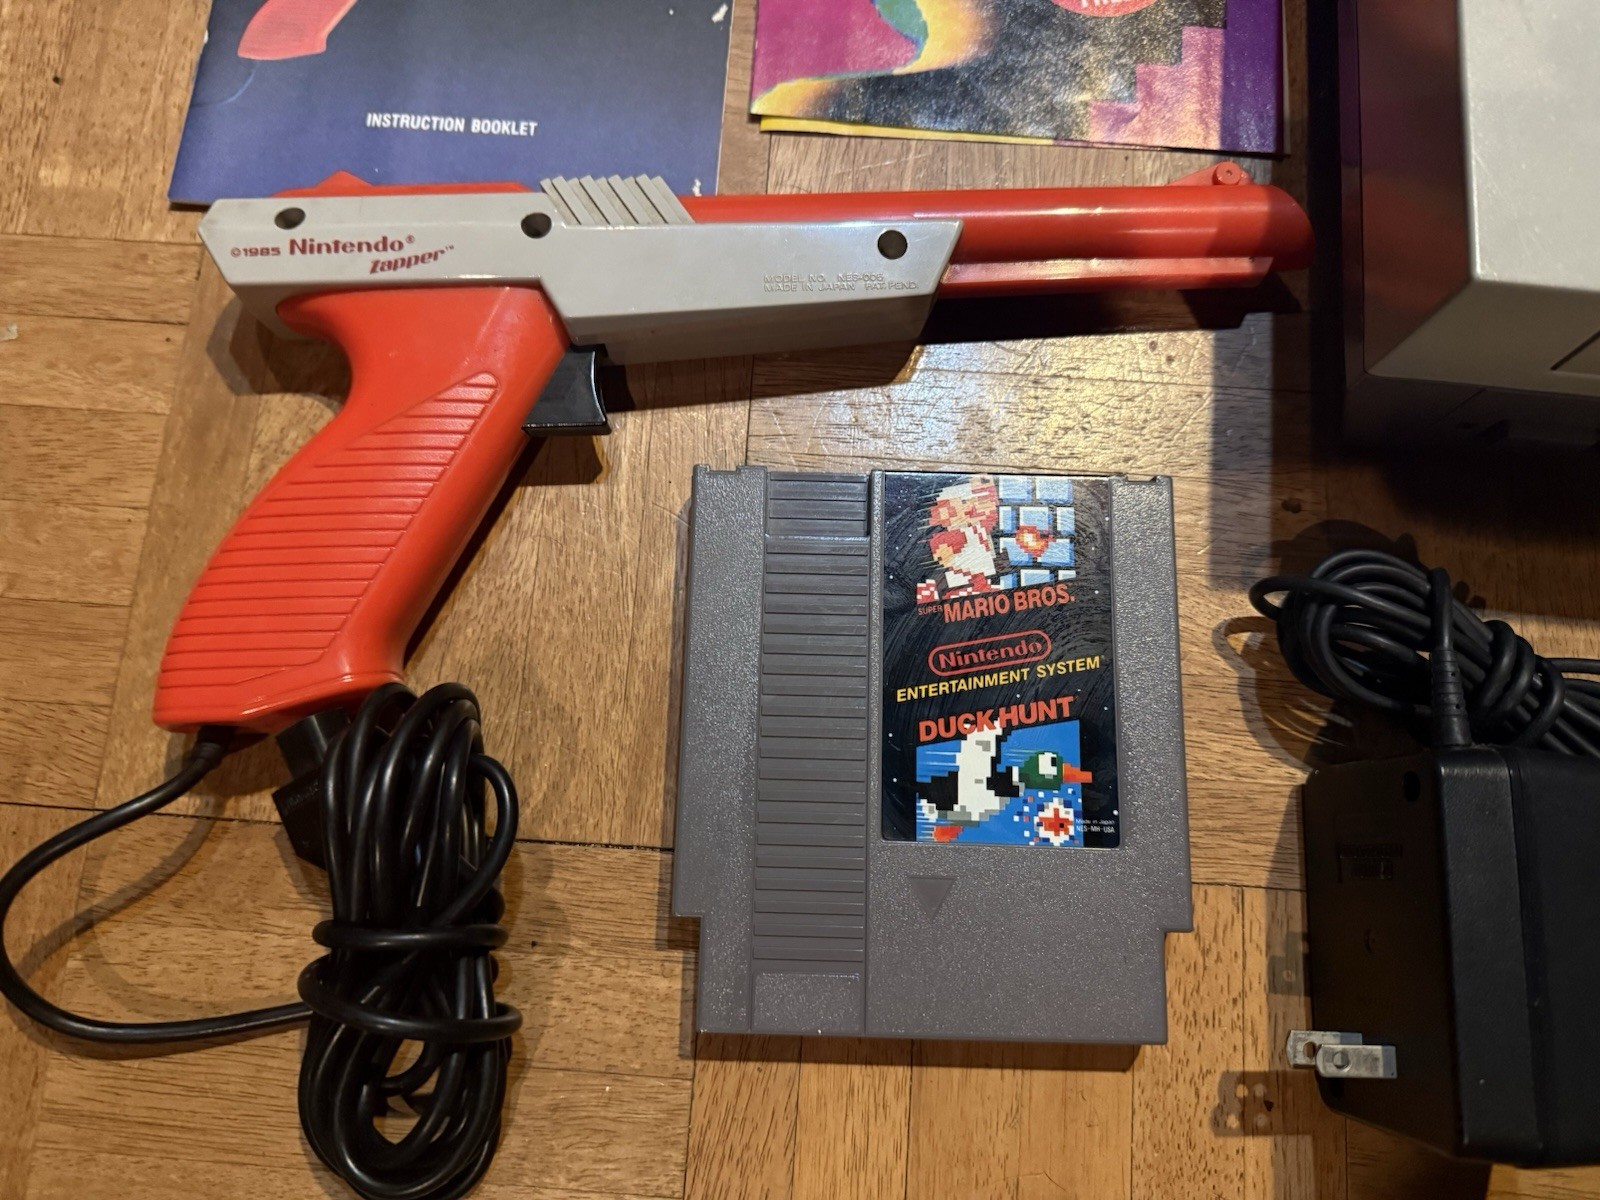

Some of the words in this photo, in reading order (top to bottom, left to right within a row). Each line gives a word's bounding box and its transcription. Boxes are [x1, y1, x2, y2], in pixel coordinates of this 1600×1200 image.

[366, 112, 465, 133] INSTRUCTION
[470, 118, 538, 137] BOOKLET
[763, 274, 804, 284] MODEL
[837, 272, 885, 283] NES-005
[763, 282, 797, 292] MADE
[801, 282, 814, 292] IN
[818, 281, 856, 292] JAPAN
[917, 604, 943, 616] SUPER
[942, 593, 1011, 624] MARIO
[1013, 583, 1077, 612] BROS.
[938, 638, 1043, 671] Nintendo
[896, 668, 1030, 703] ENTERTAINMENT
[1036, 656, 1101, 679] SYSTEM
[918, 708, 995, 743] DUCK
[998, 696, 1075, 729] HUNT
